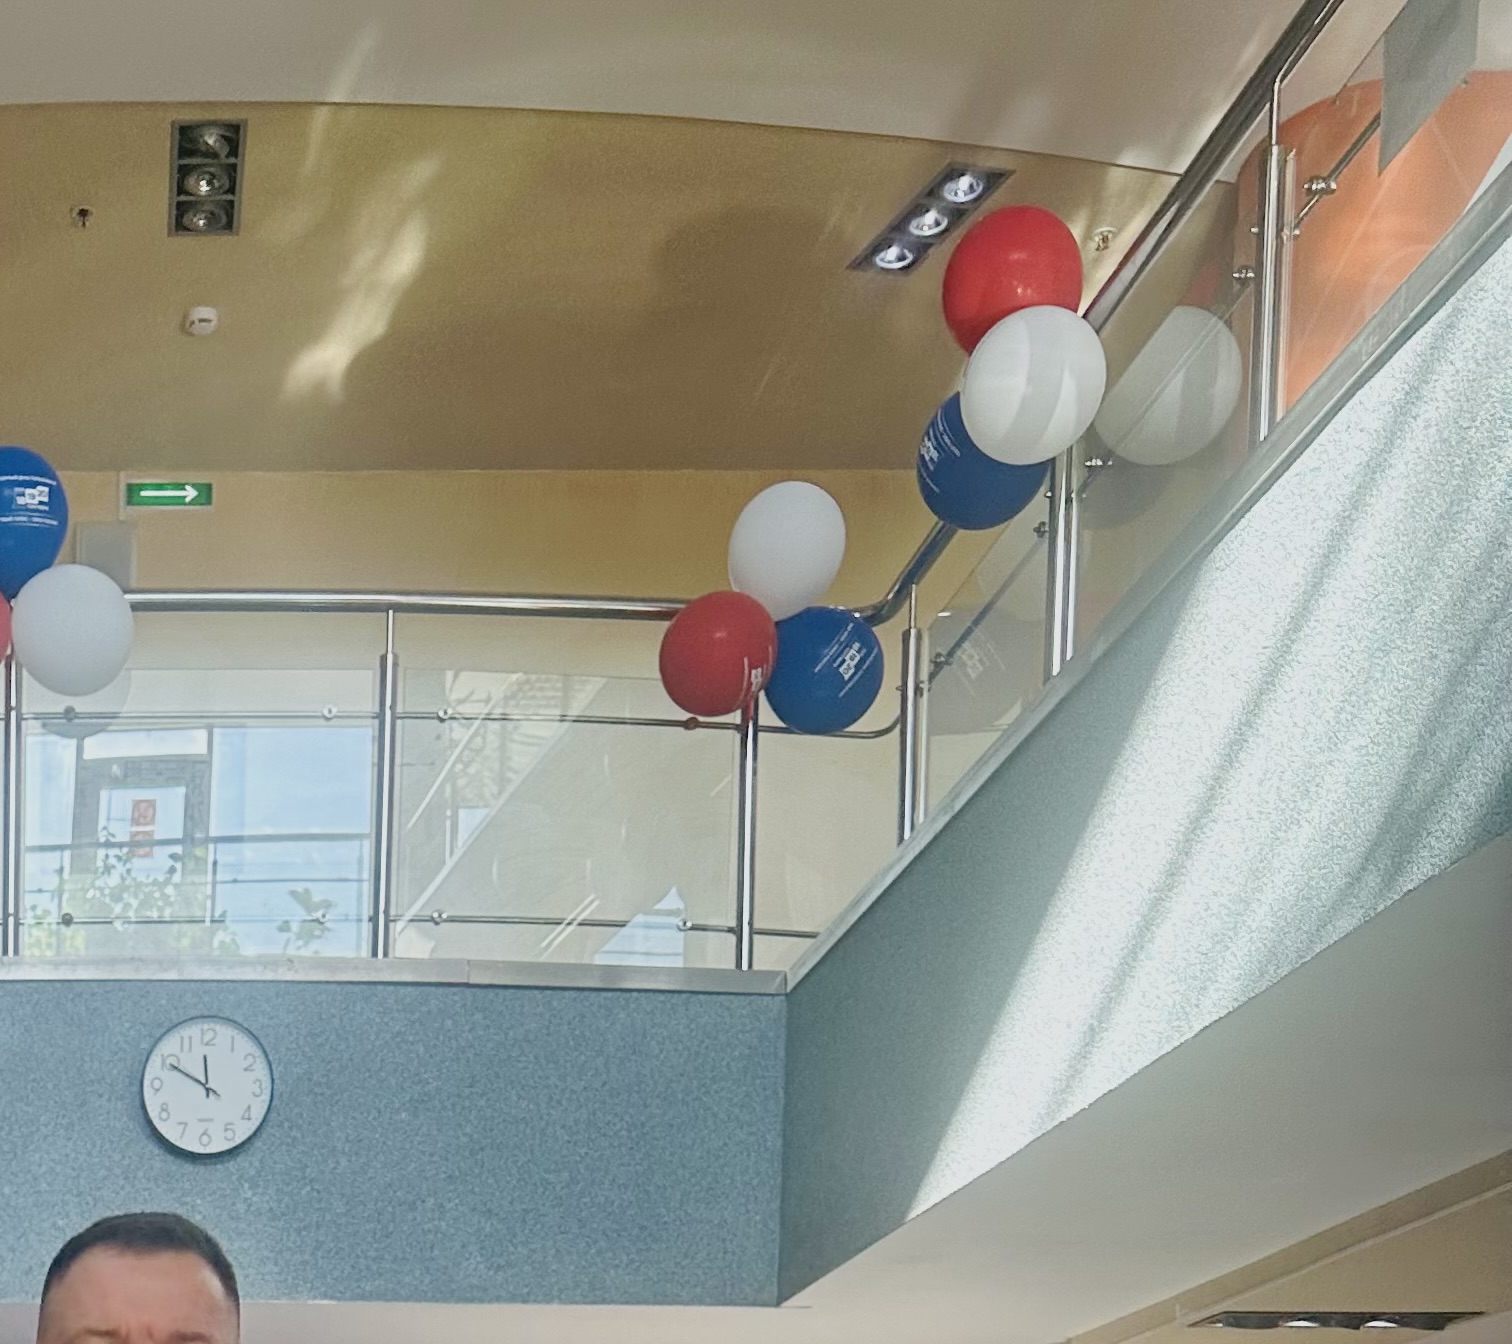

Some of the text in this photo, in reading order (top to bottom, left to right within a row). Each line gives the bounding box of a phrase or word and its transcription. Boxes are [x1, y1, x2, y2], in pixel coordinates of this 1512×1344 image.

[180, 1035, 193, 1053] 11
[200, 1027, 217, 1047] 12
[160, 1053, 181, 1072] 10
[243, 1053, 257, 1072] 2
[150, 1077, 164, 1096] 9
[252, 1079, 264, 1098] 3
[158, 1102, 171, 1122] 8
[241, 1104, 253, 1122] 4
[176, 1122, 189, 1140] 7
[198, 1128, 212, 1147] 6
[223, 1123, 236, 1141] 5
